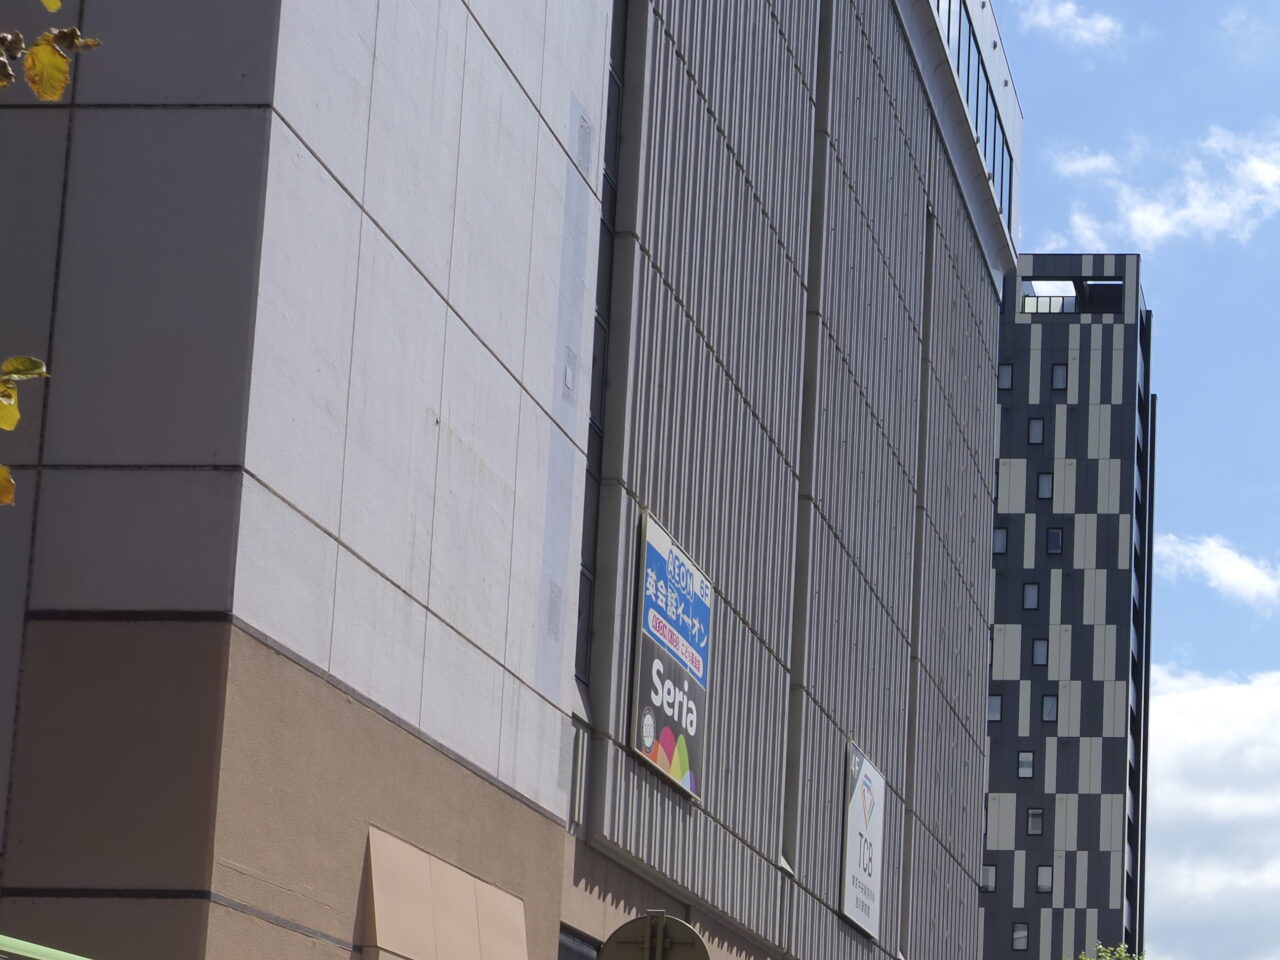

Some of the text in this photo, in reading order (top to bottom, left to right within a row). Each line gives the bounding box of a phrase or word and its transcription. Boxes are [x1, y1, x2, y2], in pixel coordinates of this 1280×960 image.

[646, 567, 708, 648] 英会話イーオン
[667, 548, 710, 603] AEON 6F
[651, 658, 697, 737] Seria
[858, 831, 873, 878] TCB
